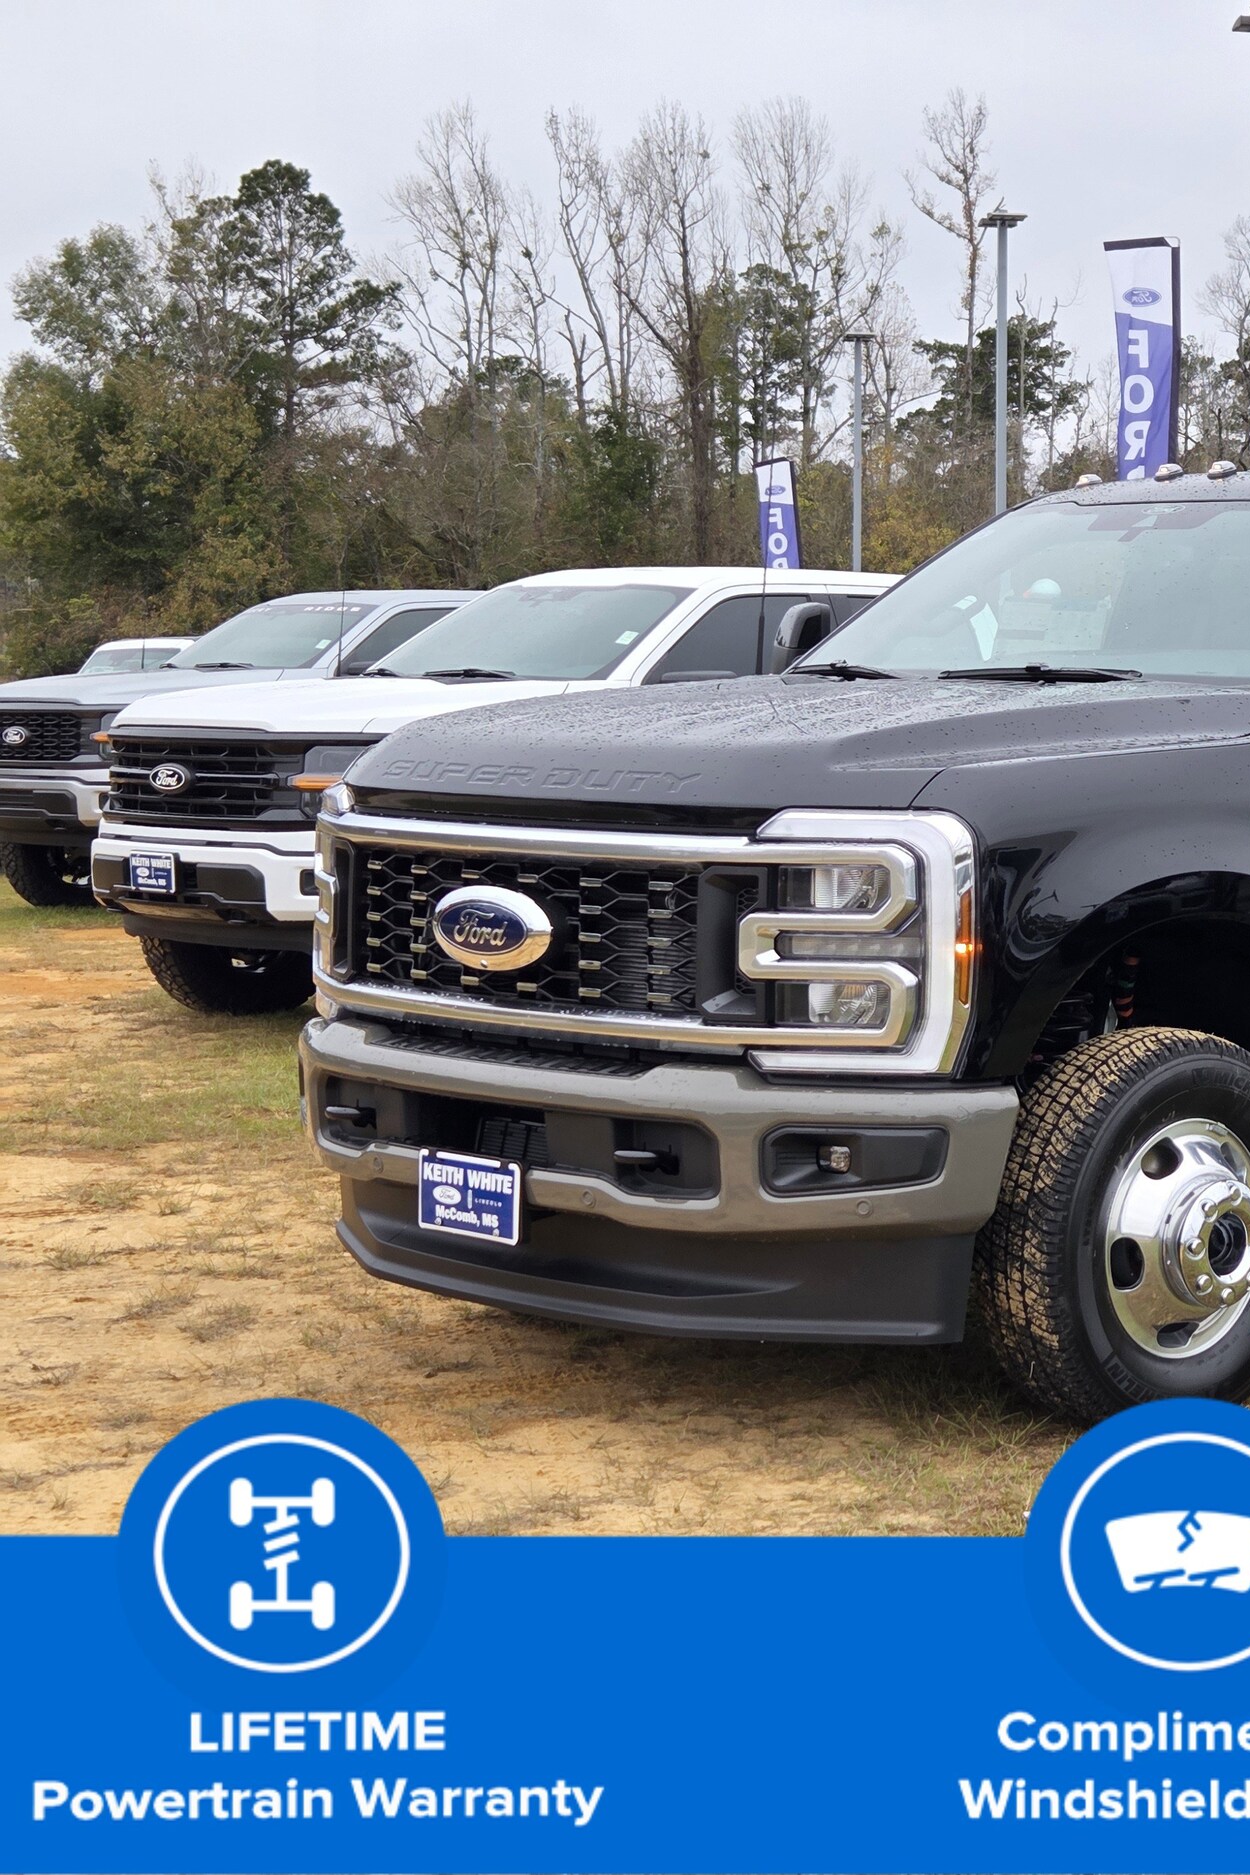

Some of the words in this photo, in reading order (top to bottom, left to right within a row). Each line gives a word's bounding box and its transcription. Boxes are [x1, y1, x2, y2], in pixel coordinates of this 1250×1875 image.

[156, 769, 178, 786] Ford
[381, 759, 538, 787] SUPER
[540, 767, 702, 793] DUTY
[453, 908, 508, 947] Ford
[423, 1161, 465, 1187] KEITH
[466, 1168, 513, 1195] WHITE
[435, 1204, 480, 1228] McComb,
[481, 1212, 499, 1229] MS
